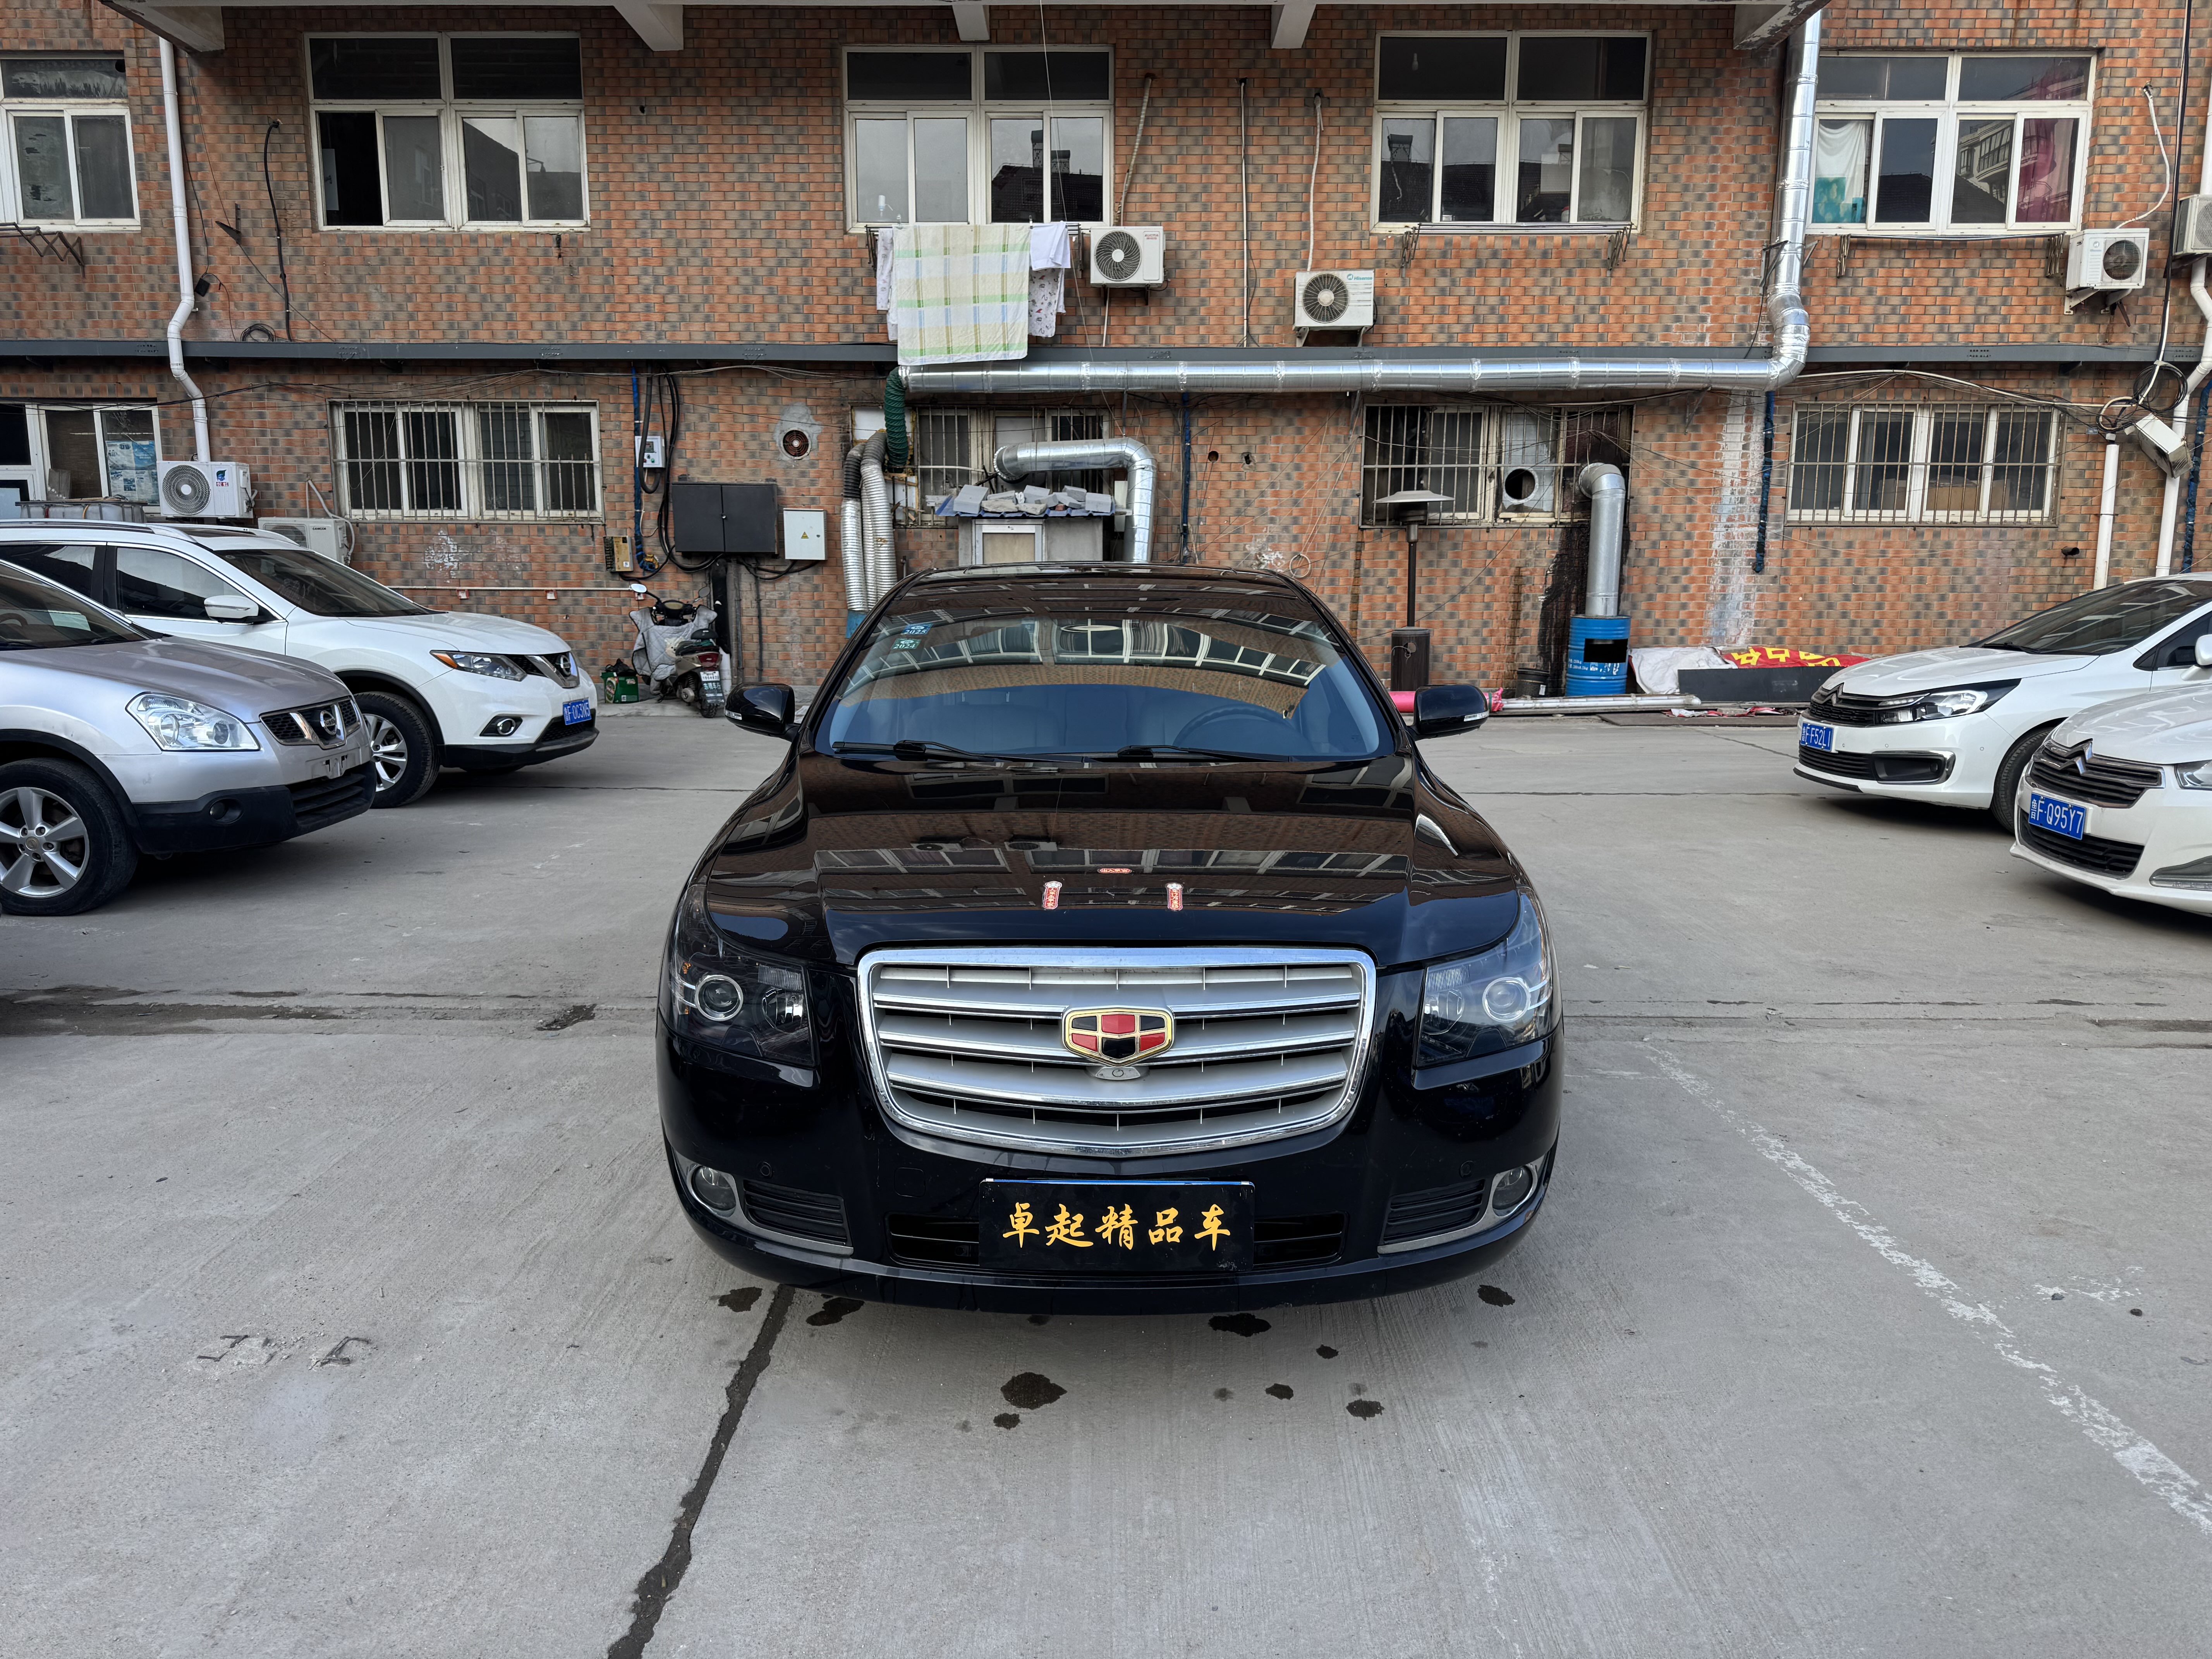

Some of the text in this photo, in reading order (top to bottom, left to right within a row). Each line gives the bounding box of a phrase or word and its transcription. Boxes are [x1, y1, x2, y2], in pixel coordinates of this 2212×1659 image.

[1003, 1202, 1231, 1250] 卓起精品车
